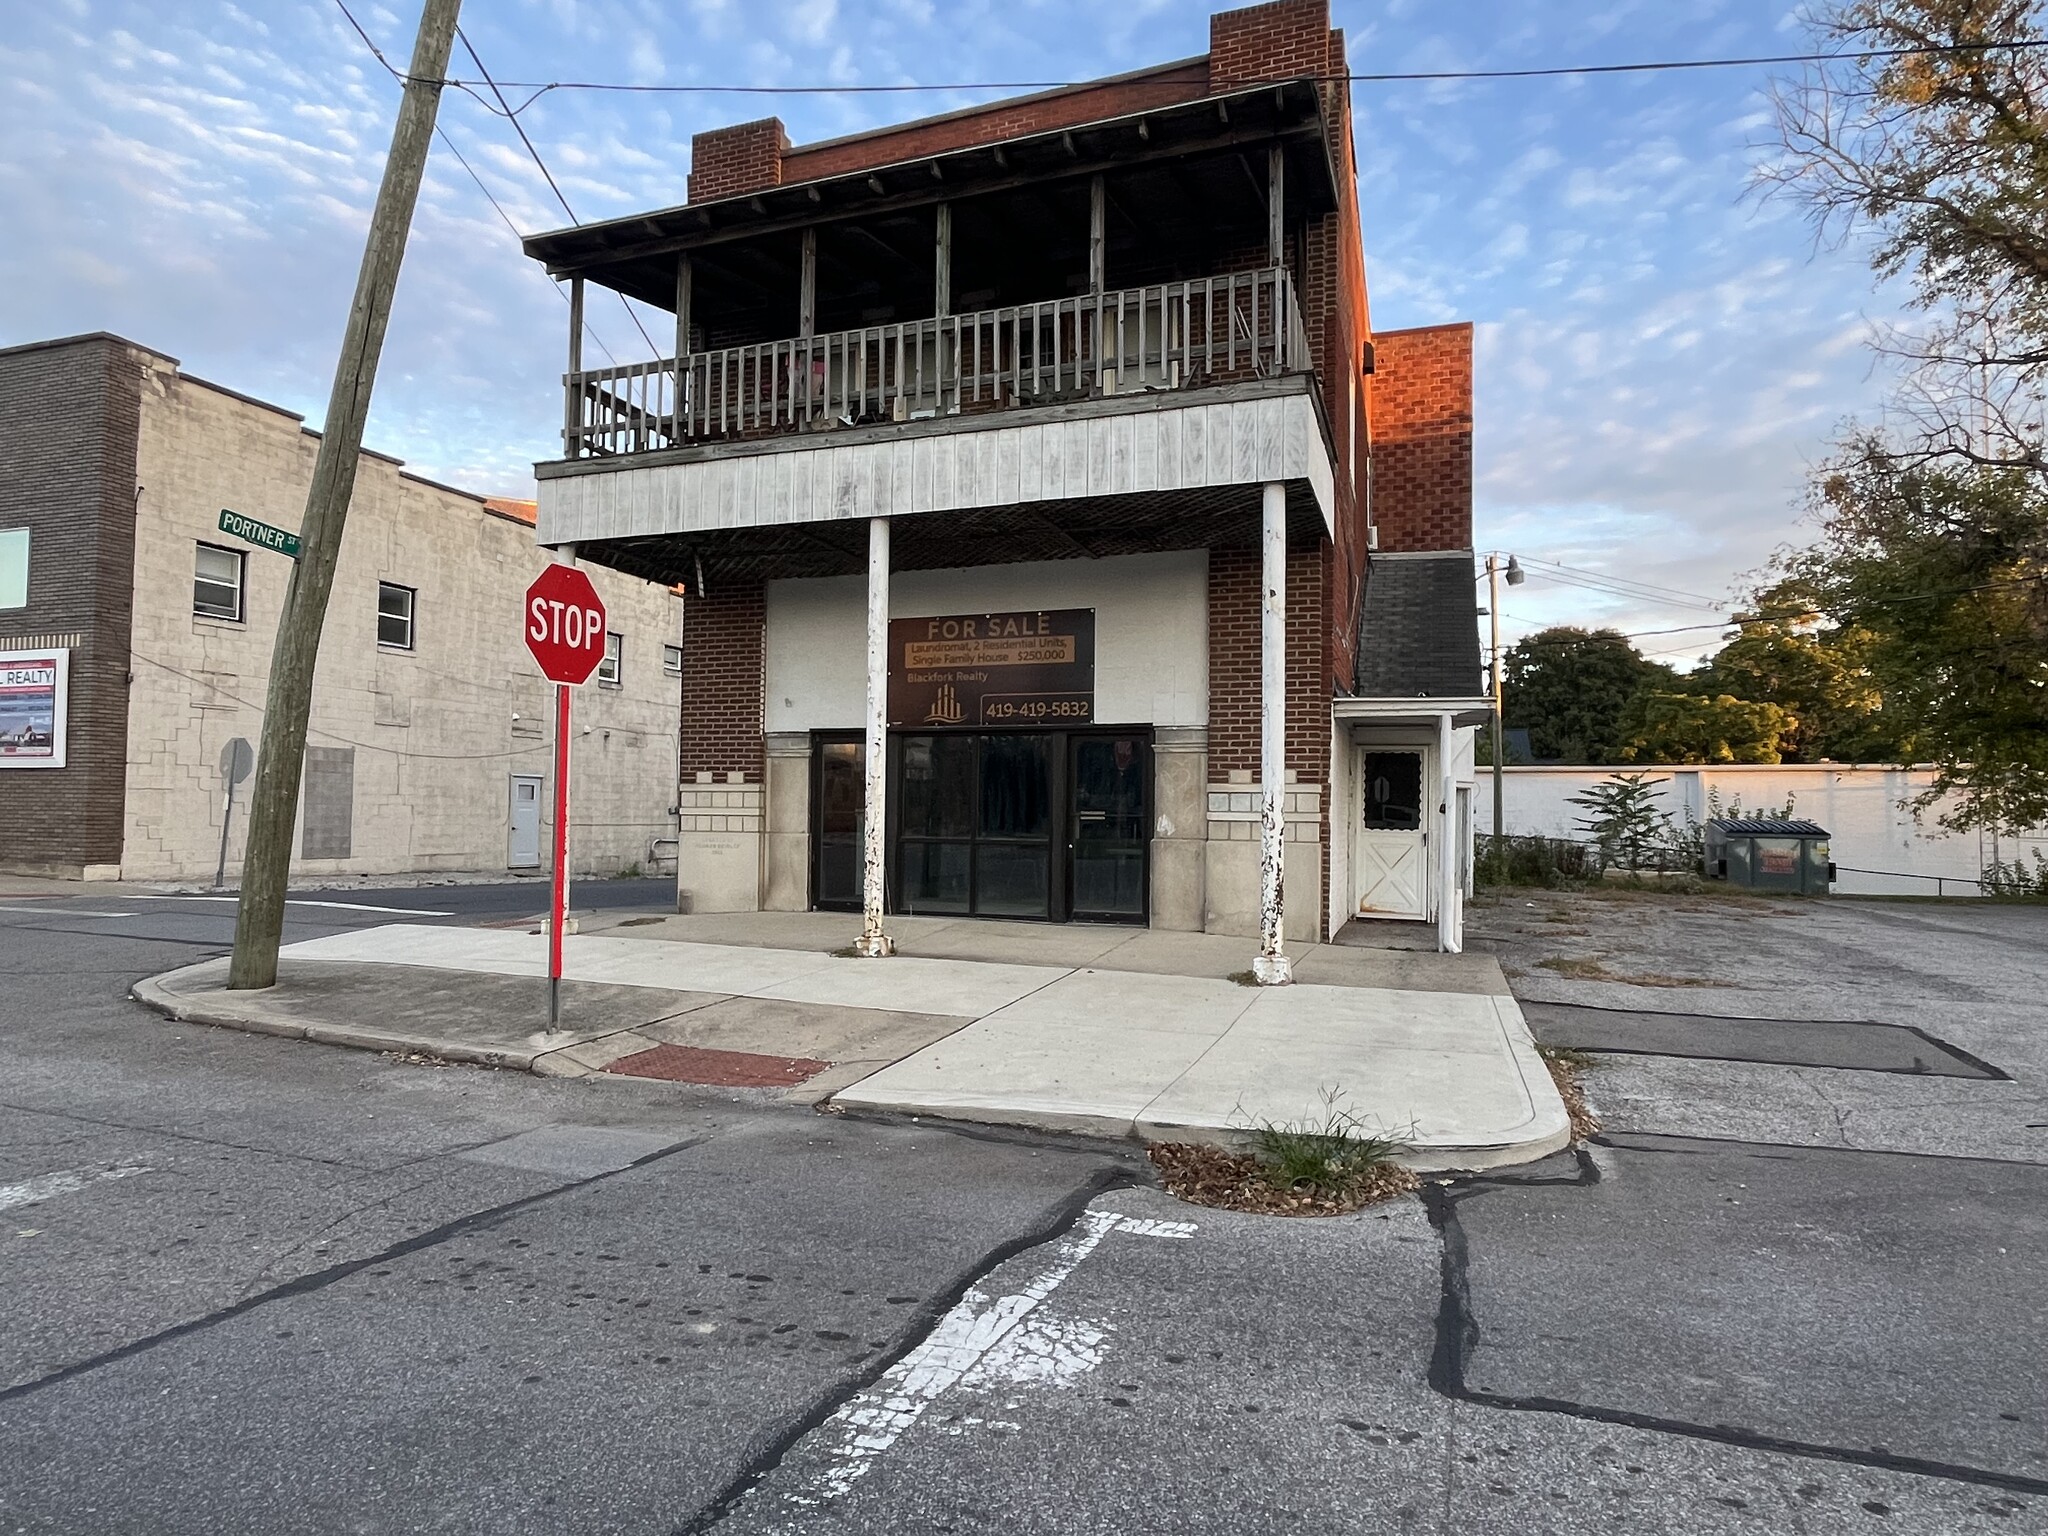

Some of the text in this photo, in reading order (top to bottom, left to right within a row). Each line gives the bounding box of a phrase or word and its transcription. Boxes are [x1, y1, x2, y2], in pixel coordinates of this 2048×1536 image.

[223, 513, 297, 549] PORTNER ST
[530, 597, 602, 651] STOP
[928, 615, 1050, 640] FOR SALE
[911, 637, 1067, 654] Laundromat, 2 Residential Units,
[913, 650, 1065, 667] Single Family House $250,000
[7, 670, 53, 684] REALTY
[907, 670, 989, 683] Blackfork Realty
[986, 701, 1089, 717] 419-419-5832
